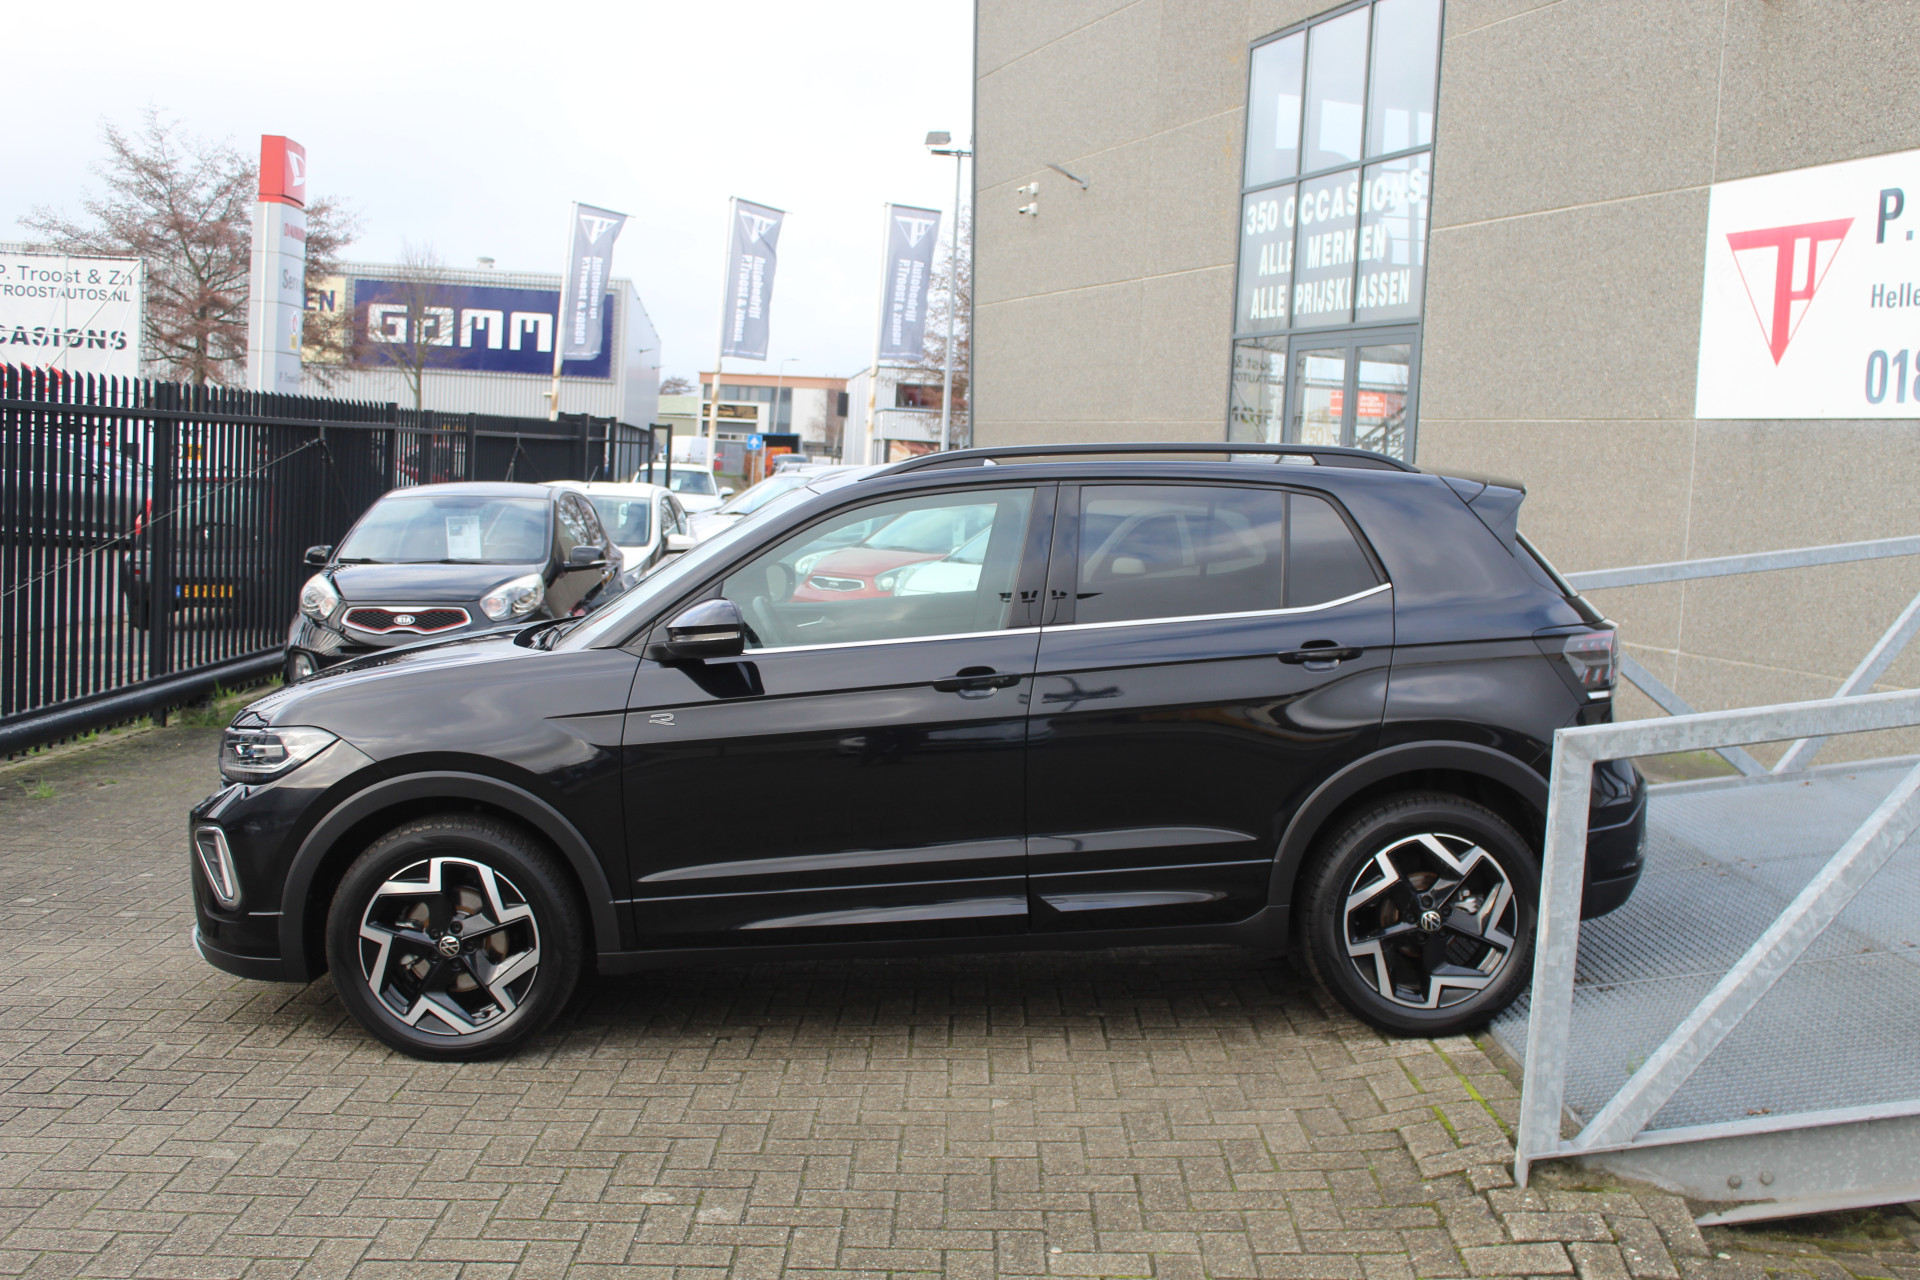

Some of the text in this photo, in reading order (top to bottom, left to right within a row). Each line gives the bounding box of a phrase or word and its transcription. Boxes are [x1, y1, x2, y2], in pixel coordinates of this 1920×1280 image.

[1246, 168, 1423, 236] 350 OCCASIONS
[1875, 187, 1914, 244] P.
[17, 265, 81, 284] Troost
[87, 269, 101, 285] &
[1258, 223, 1387, 276] ALLE MERKEN
[1250, 284, 1286, 320] ALLE
[367, 303, 553, 353] GAMM
